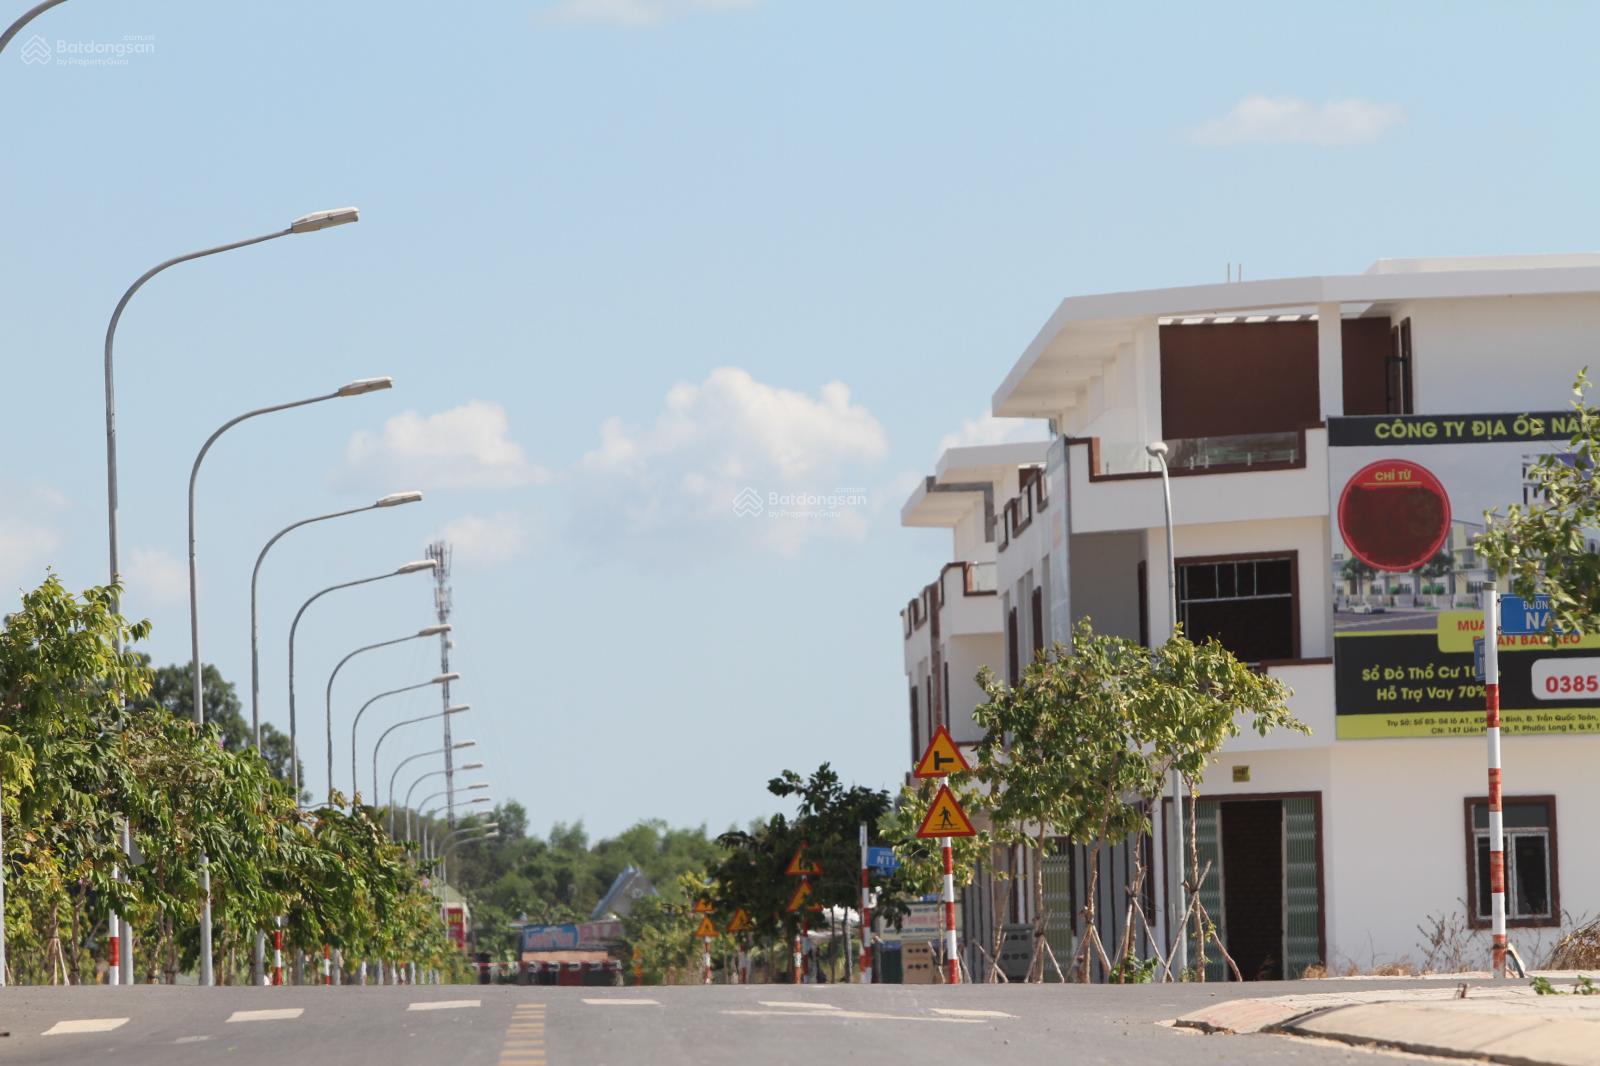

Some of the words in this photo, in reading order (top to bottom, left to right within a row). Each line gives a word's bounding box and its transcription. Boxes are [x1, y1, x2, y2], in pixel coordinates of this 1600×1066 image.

[1375, 419, 1438, 439] CÔNG
[1443, 421, 1465, 437] TY
[1472, 419, 1507, 440] ĐỊA
[1523, 599, 1551, 610] ĐƯỜN
[1408, 663, 1434, 679] Thổ
[1438, 666, 1460, 678] Cư
[1545, 675, 1599, 693] 0385
[1376, 685, 1397, 700] Hỗ
[1401, 687, 1423, 702] Trợ
[1426, 687, 1454, 702] Vay
[1458, 685, 1487, 698] 70%
[1448, 726, 1461, 734] 147
